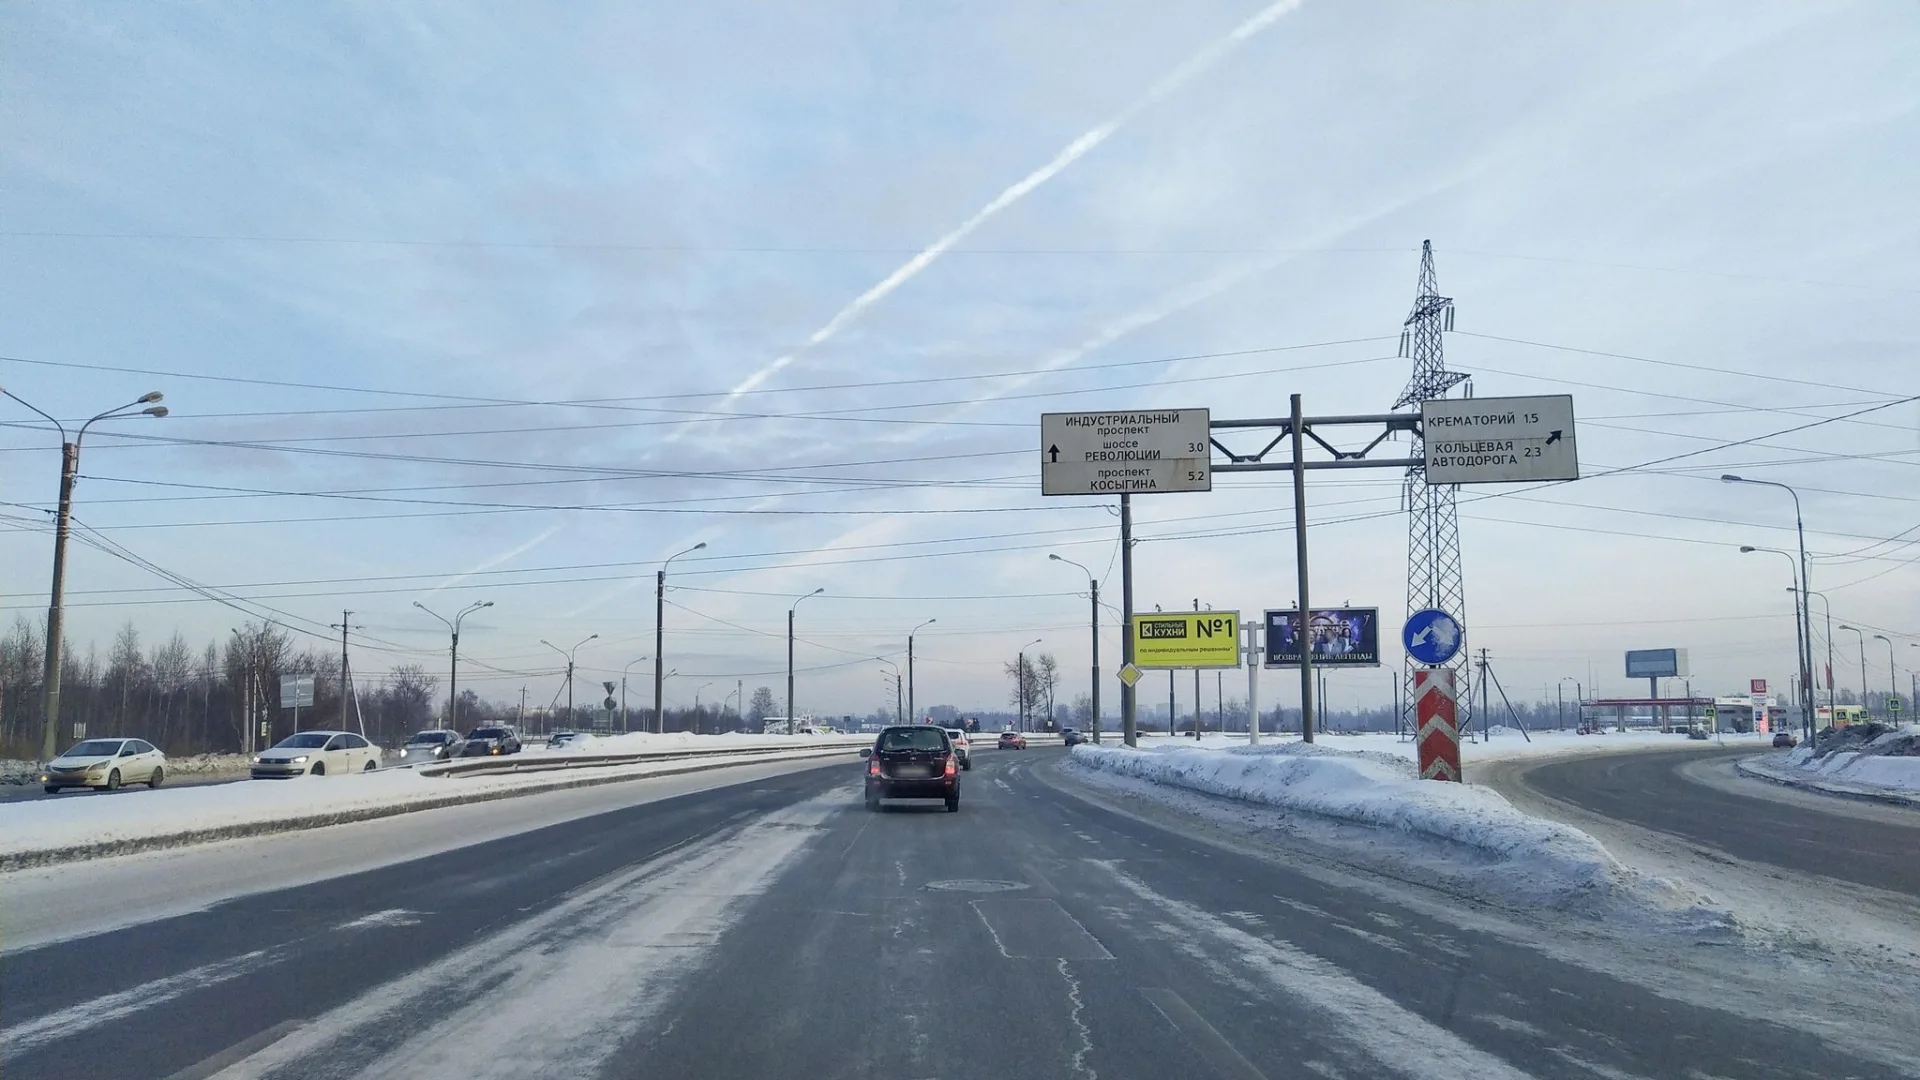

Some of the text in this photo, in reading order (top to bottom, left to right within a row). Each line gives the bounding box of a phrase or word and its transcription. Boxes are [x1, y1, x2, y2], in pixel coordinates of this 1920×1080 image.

[1065, 410, 1180, 427] ИНДУСТРИАЛЬНЫЙ
[1428, 411, 1539, 427] КРЕМАТОРИЙ 1.5
[1097, 426, 1150, 437] проспект
[1102, 440, 1139, 449] шоссе
[1188, 442, 1204, 453] 3.0
[1435, 441, 1513, 454] КОЛЬЦЕВАЯ
[1085, 450, 1161, 461] РЕВОЛЮЦИИ
[1523, 447, 1542, 458] 2.3
[1431, 454, 1518, 467] АВТОДОРОГА
[1098, 468, 1151, 479] проспект
[1188, 471, 1205, 482] 5.2
[1090, 479, 1157, 491] КОСЫГИНА
[1154, 628, 1185, 636] КУХНИ
[1273, 653, 1332, 661] ВОЗВРАЕНИЕ
